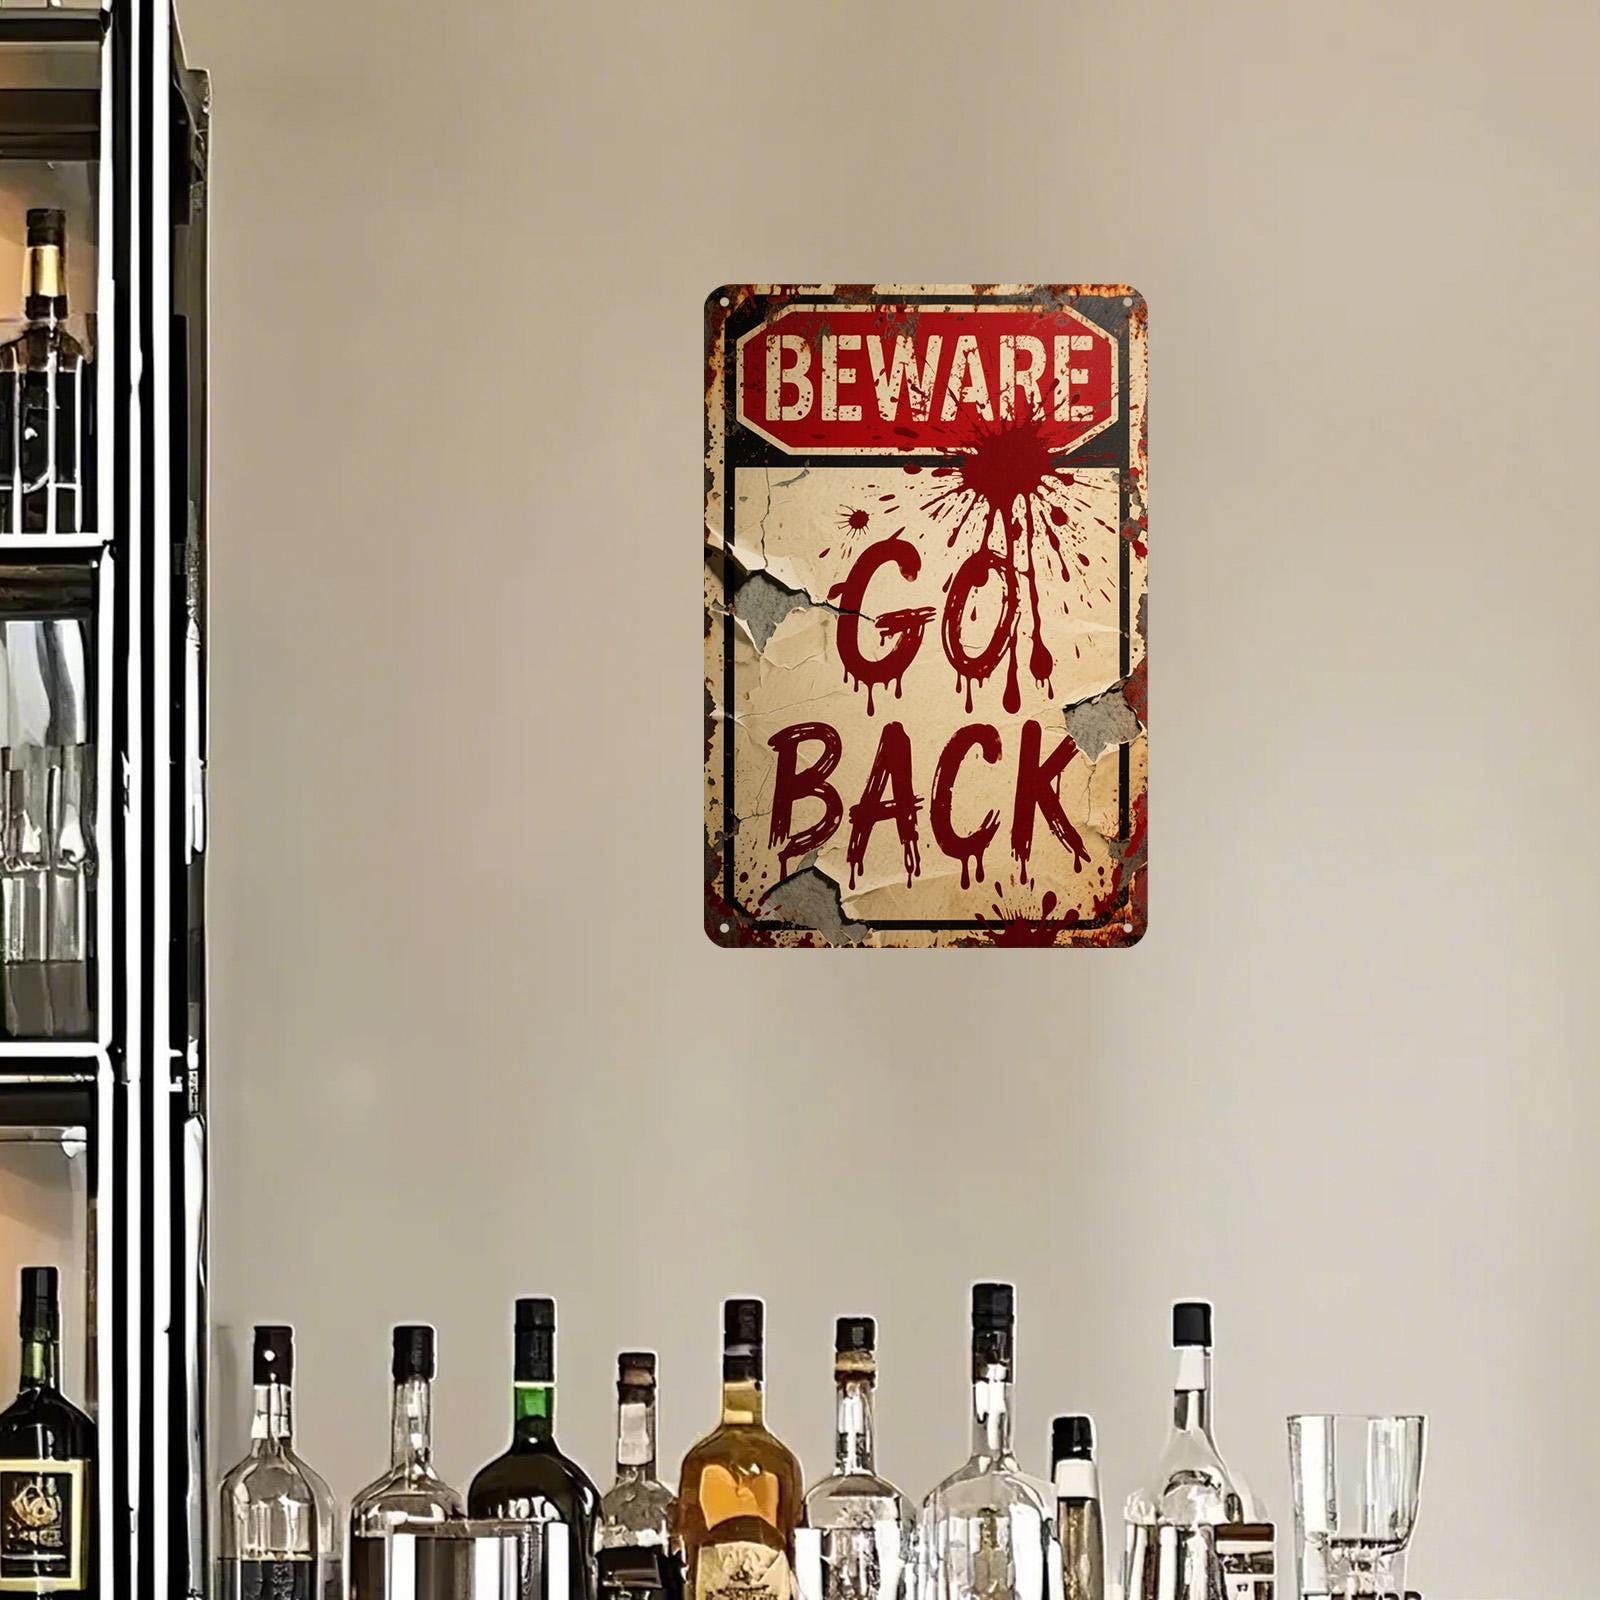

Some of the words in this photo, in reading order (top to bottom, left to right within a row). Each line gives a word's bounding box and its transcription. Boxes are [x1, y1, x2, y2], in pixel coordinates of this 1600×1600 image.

[765, 334, 1094, 423] BEWARE
[828, 537, 1021, 714] GO
[767, 720, 1091, 889] BACK
